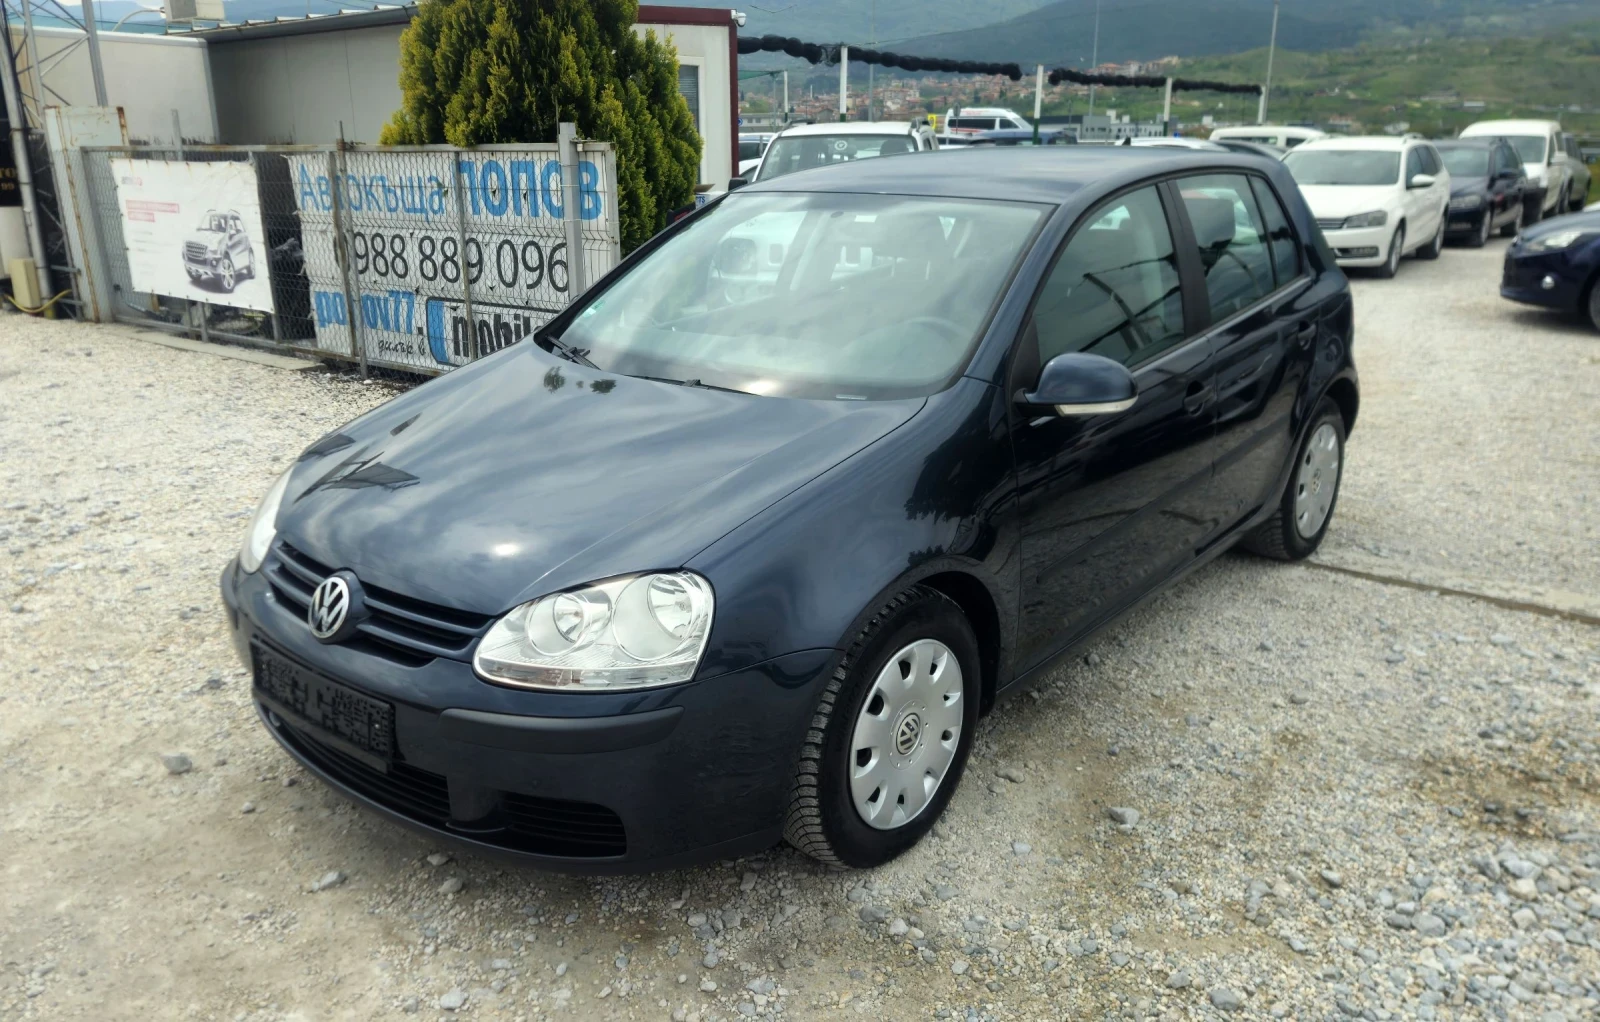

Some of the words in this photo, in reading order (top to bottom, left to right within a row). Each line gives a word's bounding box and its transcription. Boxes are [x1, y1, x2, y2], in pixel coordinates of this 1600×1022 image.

[418, 235, 483, 285] 889
[496, 239, 568, 293] 096
[453, 313, 541, 359] mobi
